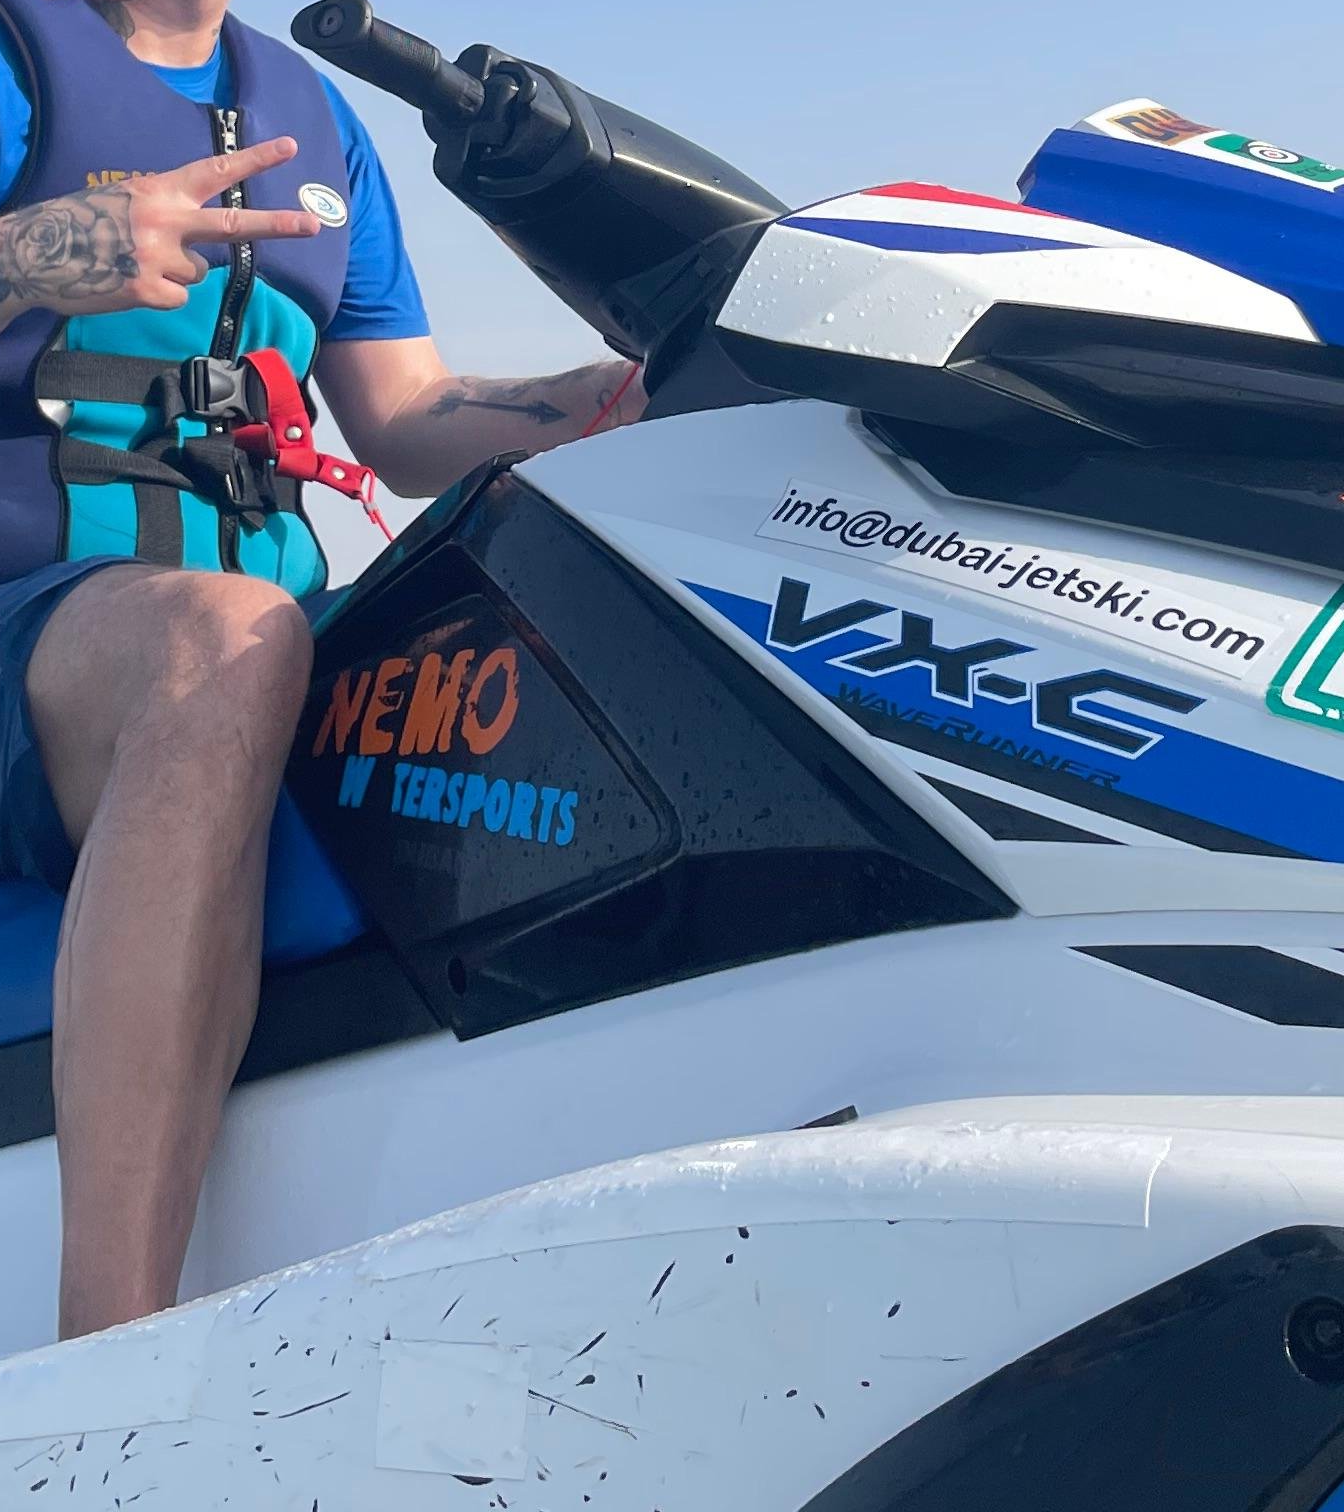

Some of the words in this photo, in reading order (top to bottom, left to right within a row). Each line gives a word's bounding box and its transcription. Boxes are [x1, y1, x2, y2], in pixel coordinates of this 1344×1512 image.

[772, 489, 1265, 660] info@dubai-jetski.com
[312, 647, 519, 758] NEMO
[767, 576, 1208, 759] VX-C
[338, 755, 578, 846] WTERSPORTS
